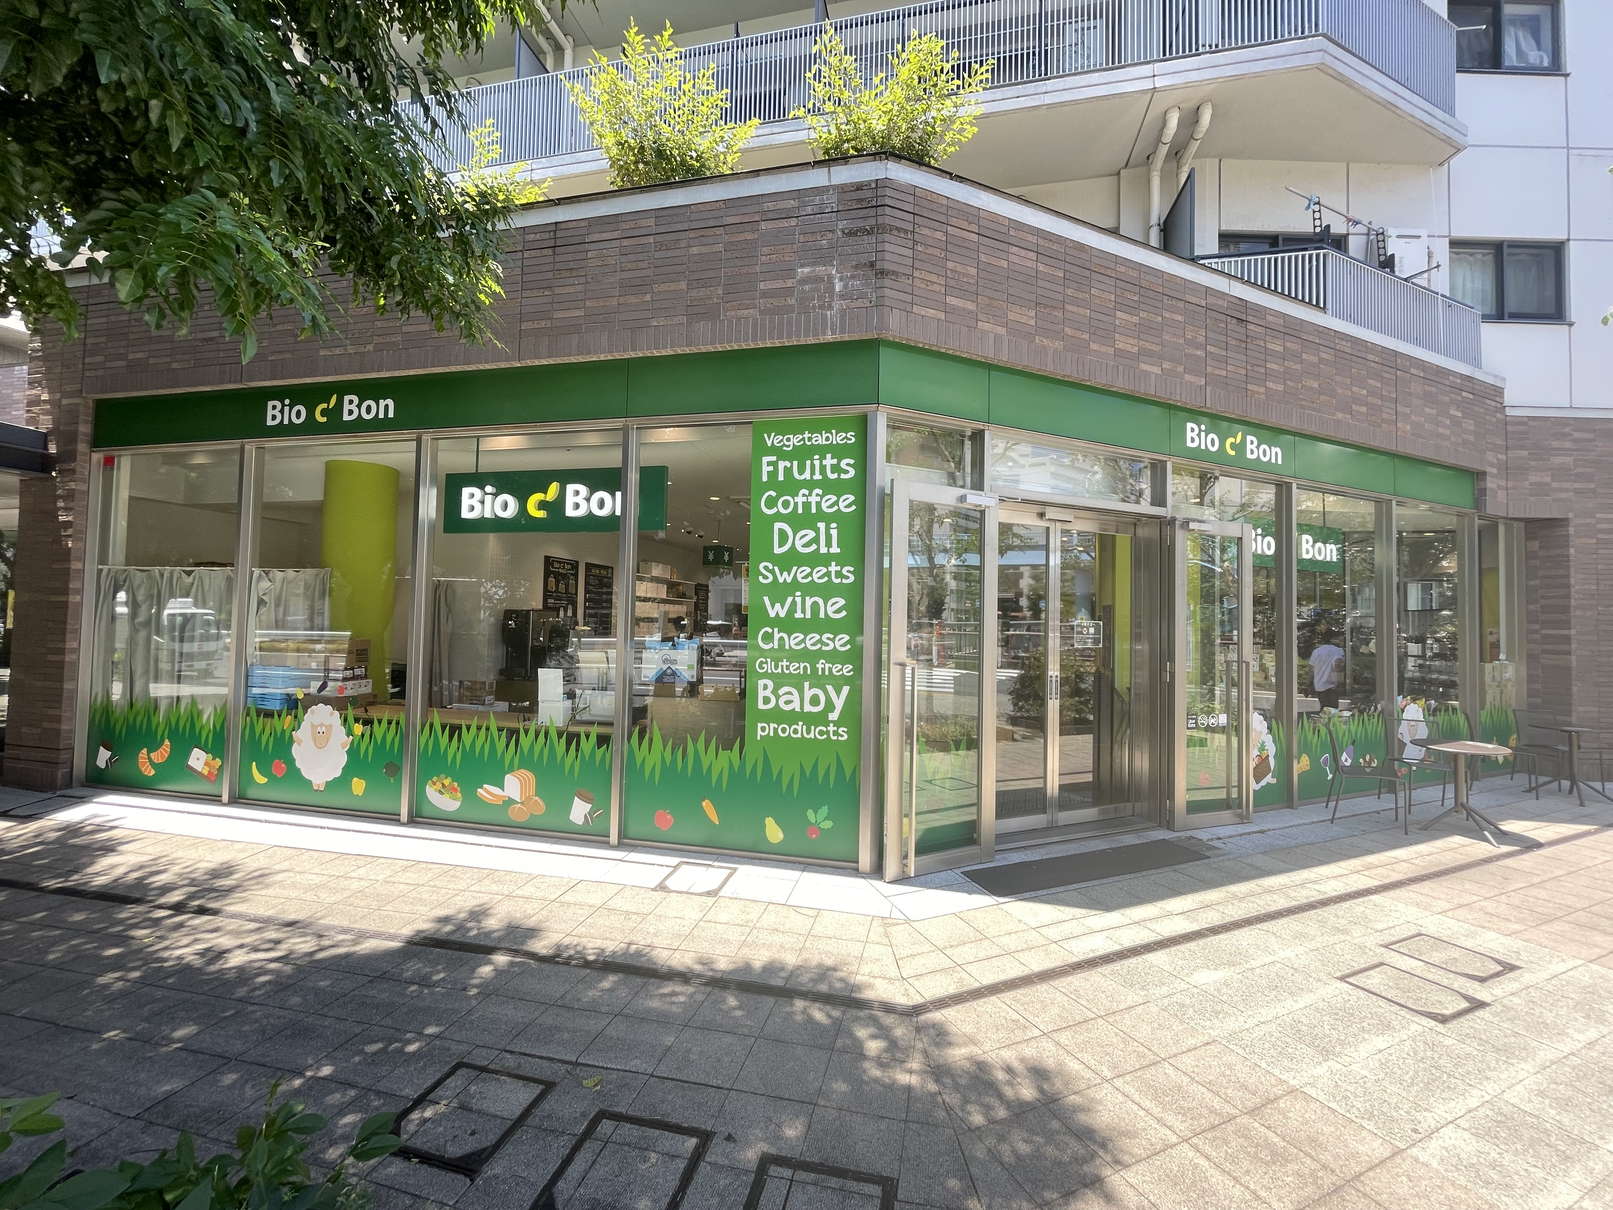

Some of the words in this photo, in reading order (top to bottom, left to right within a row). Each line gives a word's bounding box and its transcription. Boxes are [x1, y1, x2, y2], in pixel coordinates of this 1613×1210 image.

[266, 399, 306, 426] Bio
[342, 394, 395, 421] Bon
[763, 429, 856, 451] Vegetables
[1186, 422, 1219, 452] Bio
[1246, 435, 1282, 465] Bon
[761, 453, 856, 482] Fruits
[460, 484, 519, 519] Bio
[760, 488, 857, 515] Coffee
[773, 521, 841, 555] Deli
[1301, 534, 1337, 562] Bon
[758, 561, 855, 584] Sweets
[757, 626, 851, 651] Cheese
[755, 657, 811, 675] Gluten
[816, 659, 854, 676] free
[757, 678, 850, 721] Baby
[756, 722, 848, 741] products
